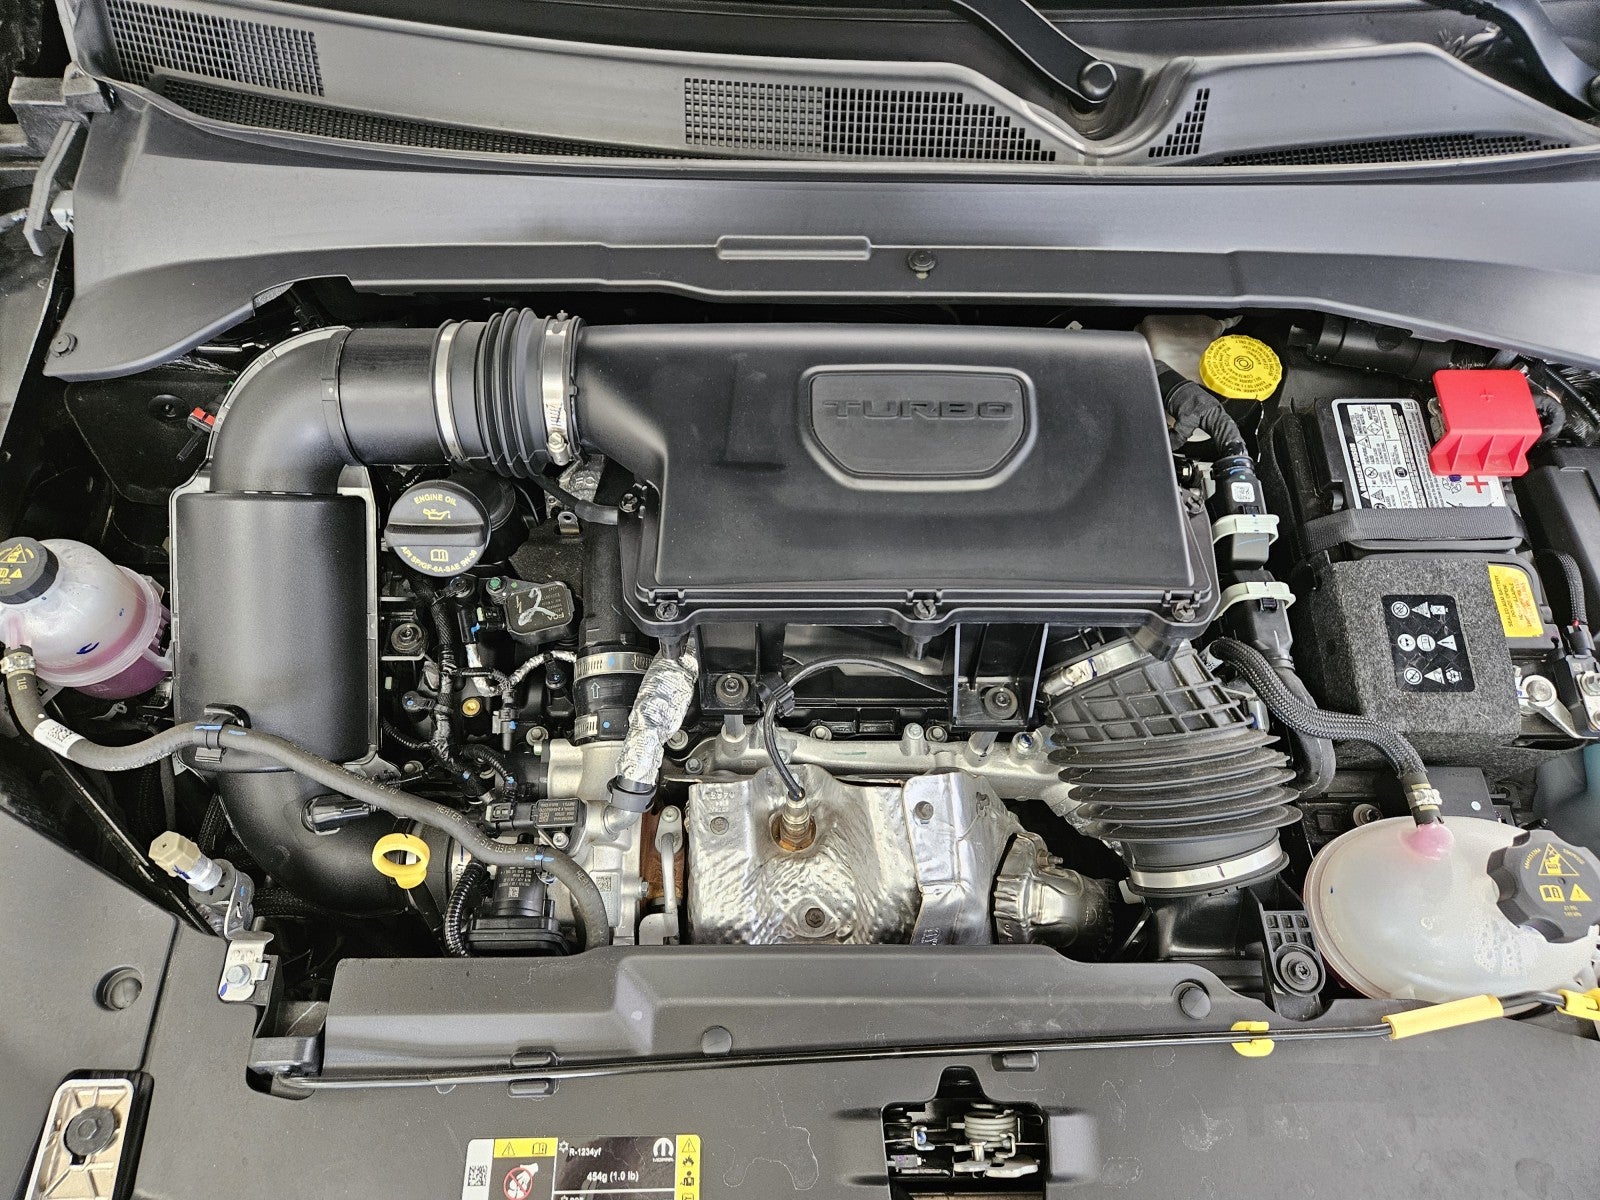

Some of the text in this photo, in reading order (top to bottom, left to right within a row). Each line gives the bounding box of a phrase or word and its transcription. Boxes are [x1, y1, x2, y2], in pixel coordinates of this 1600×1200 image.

[823, 400, 1014, 420] TURBO
[414, 493, 456, 506] ENGINE OIL
[436, 806, 462, 823] HEATER
[569, 1148, 602, 1158] R-1234yf
[586, 1170, 639, 1183] 454g (1.0 lb)
